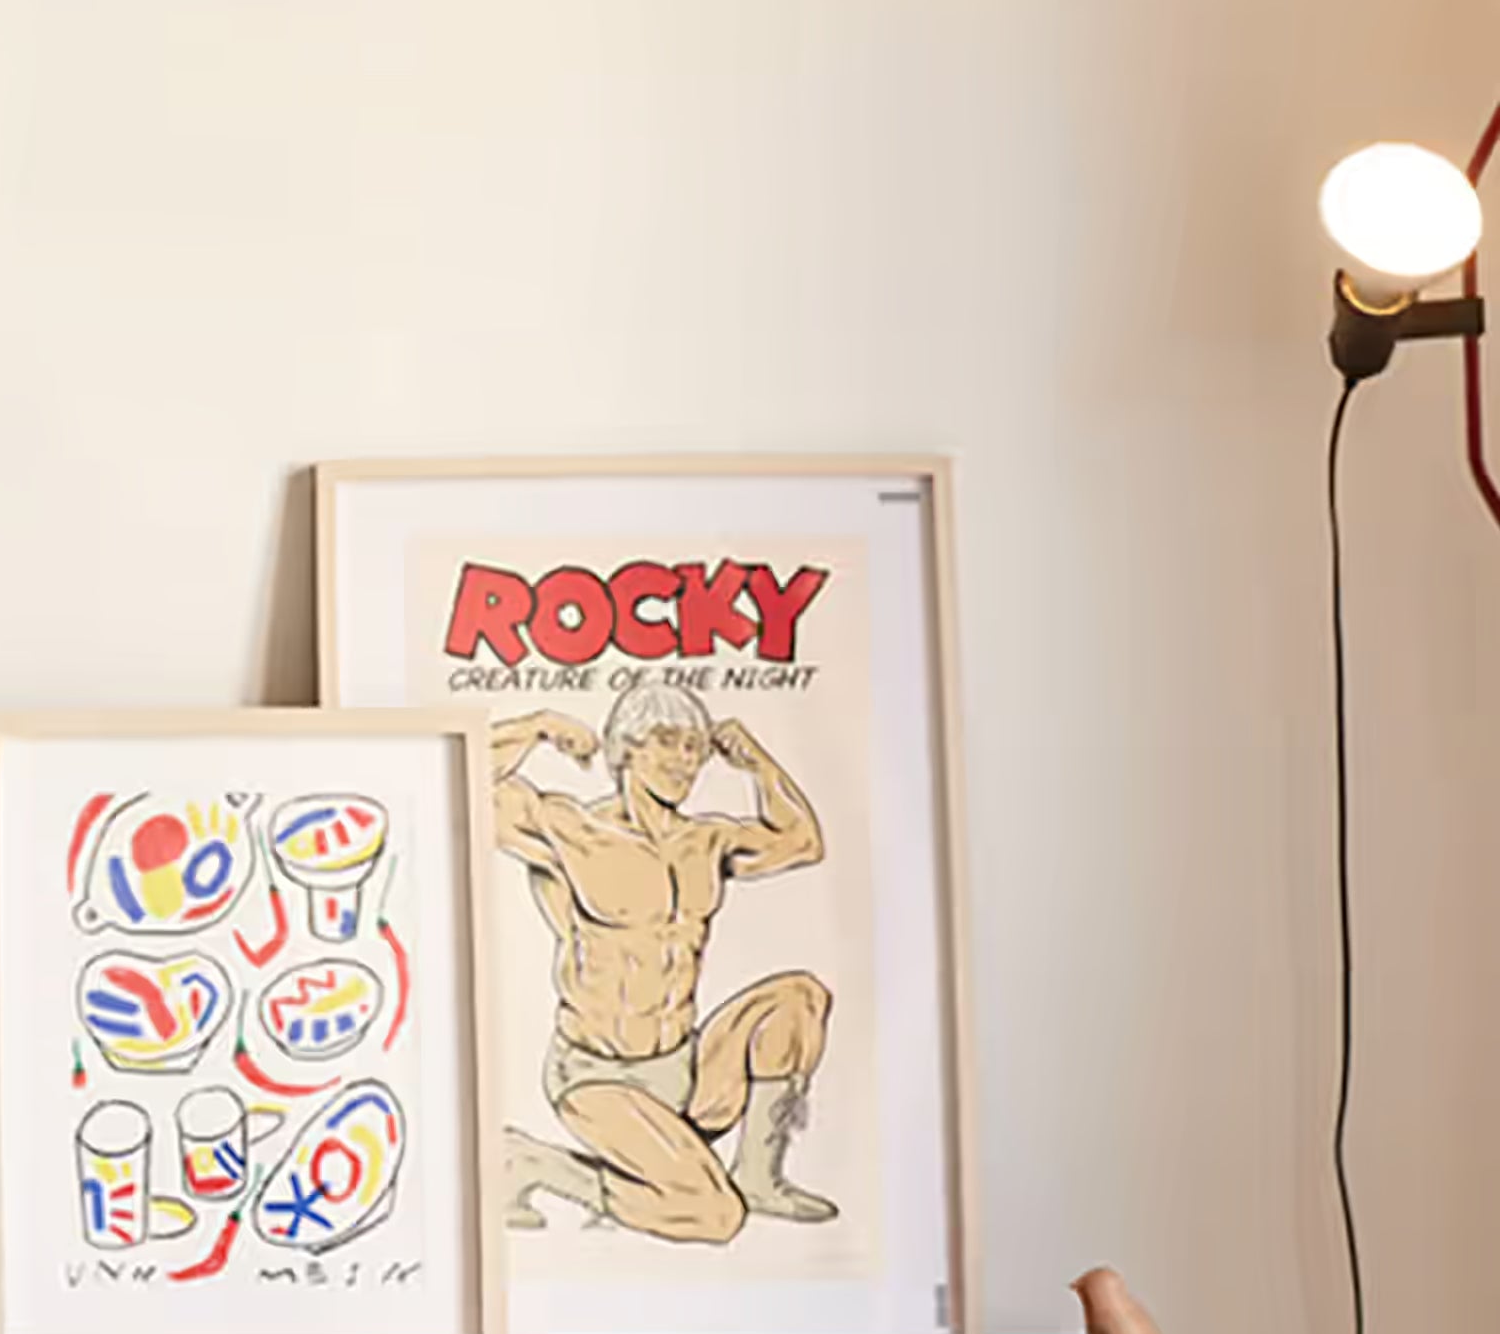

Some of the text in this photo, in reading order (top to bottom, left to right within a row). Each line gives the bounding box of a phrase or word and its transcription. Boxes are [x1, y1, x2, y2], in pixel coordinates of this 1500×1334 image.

[443, 558, 830, 667] ROCKY
[449, 666, 818, 691] CREATURE OF THE NIGHT
